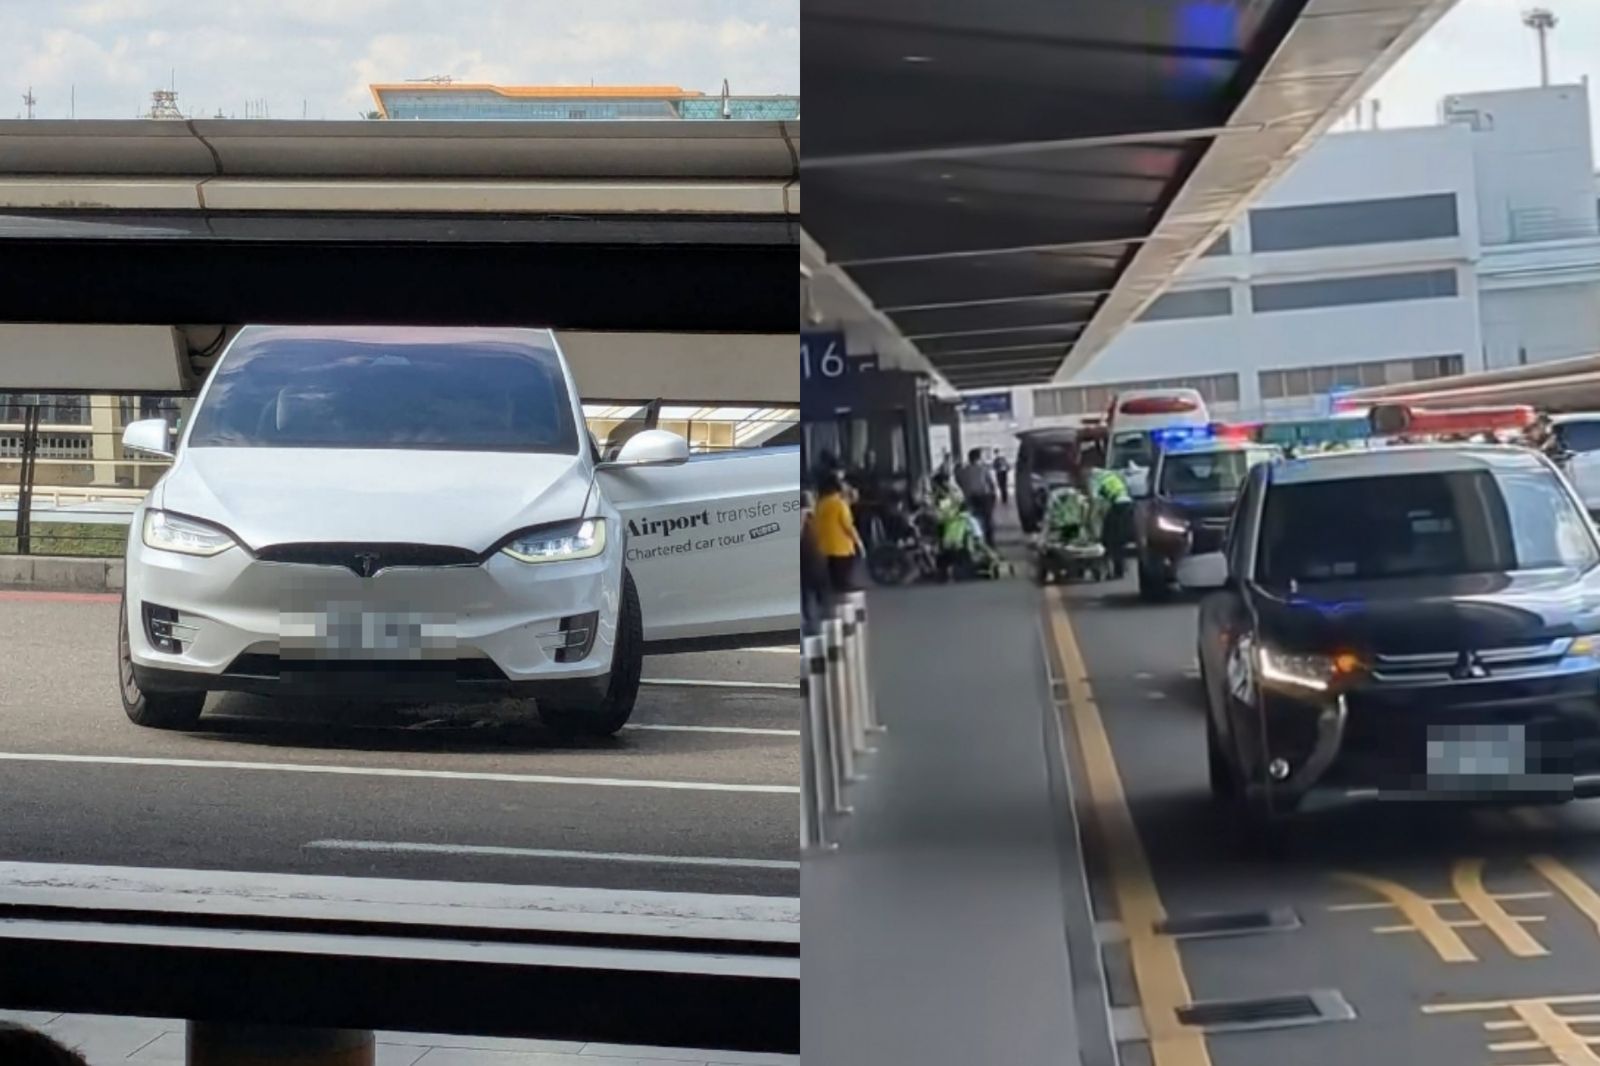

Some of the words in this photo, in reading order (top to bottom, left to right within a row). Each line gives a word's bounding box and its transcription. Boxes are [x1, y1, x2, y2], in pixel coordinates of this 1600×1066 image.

[800, 341, 844, 379] 16
[626, 509, 710, 537] Airport
[716, 501, 778, 524] transfer
[626, 539, 692, 562] Chartered
[695, 538, 715, 550] car
[719, 532, 747, 547] tour
